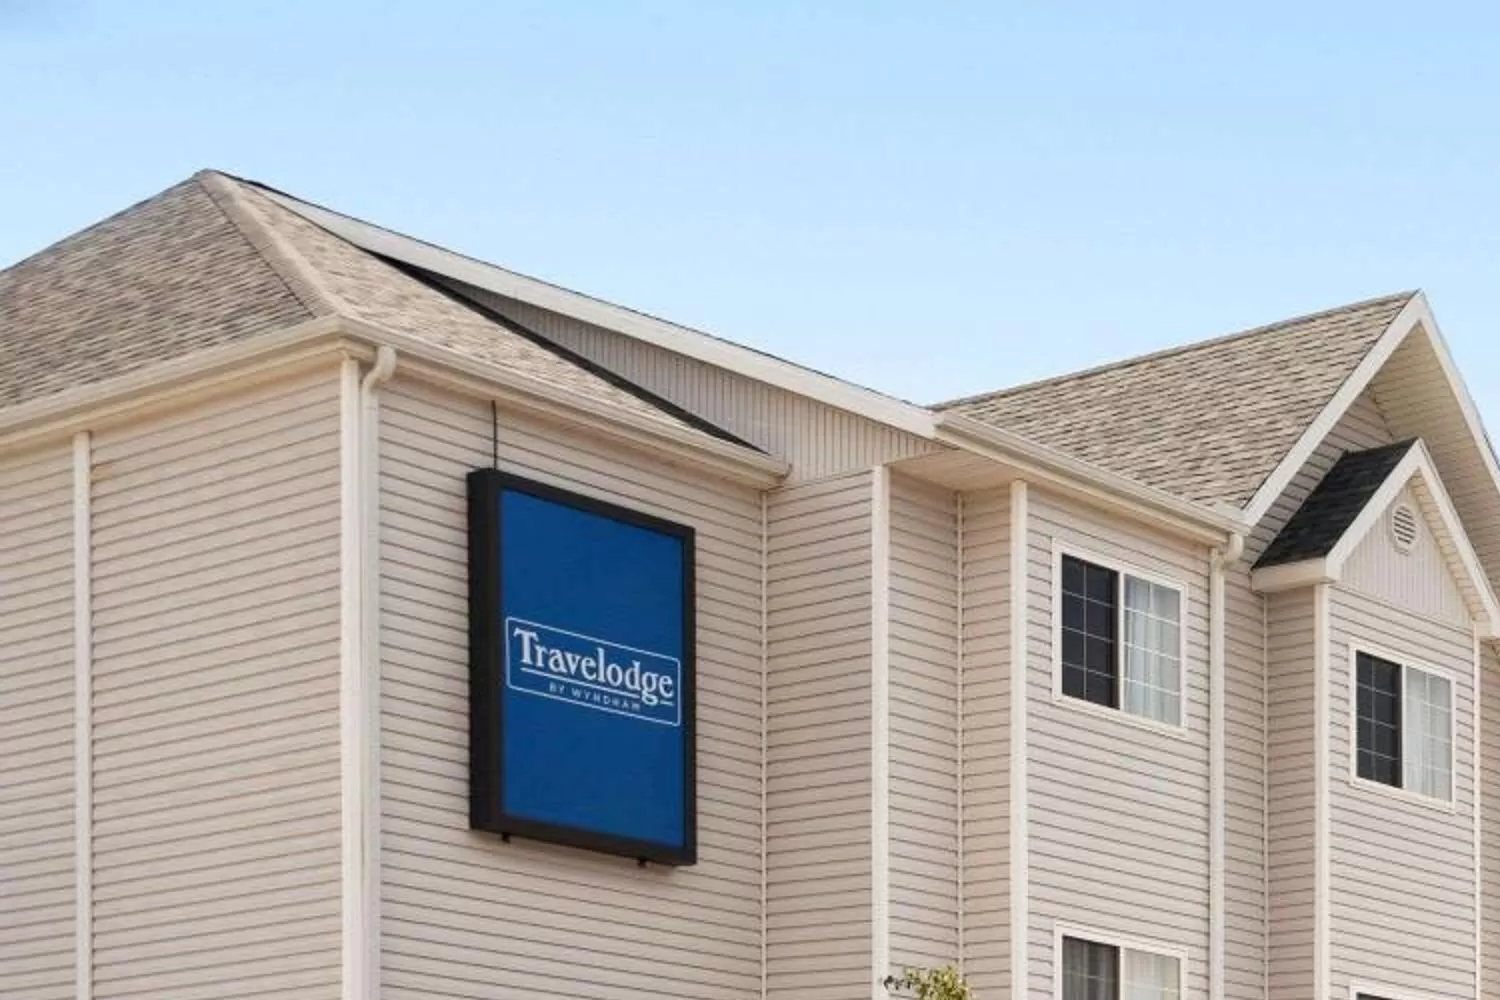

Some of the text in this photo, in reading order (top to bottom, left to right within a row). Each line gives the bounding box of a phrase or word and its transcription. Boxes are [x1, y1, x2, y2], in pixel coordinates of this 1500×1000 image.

[513, 627, 674, 706] Travelodge
[549, 682, 641, 712] BY WYNDHAM
